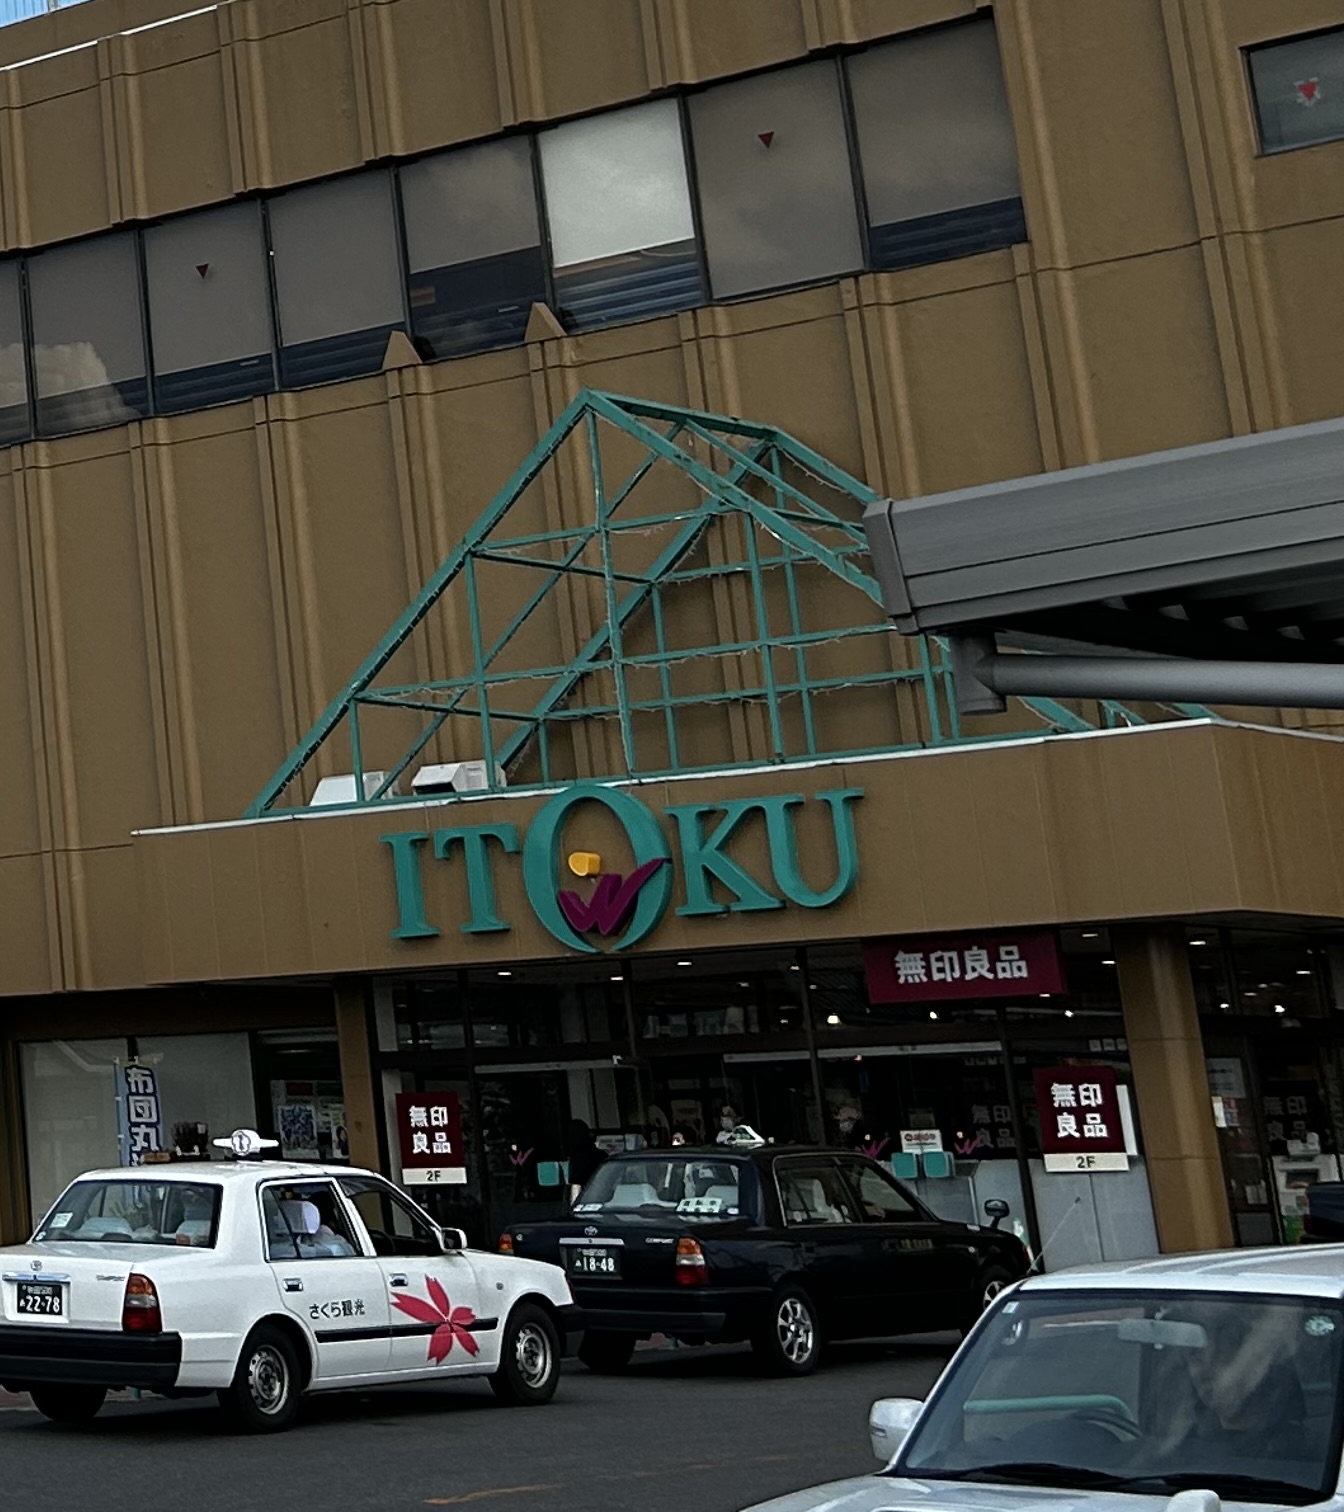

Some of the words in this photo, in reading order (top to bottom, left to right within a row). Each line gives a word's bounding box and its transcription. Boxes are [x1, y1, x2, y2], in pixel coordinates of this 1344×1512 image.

[380, 782, 866, 954] ITOKU
[894, 945, 1029, 984] 無印良品
[1051, 1082, 1103, 1108] 無印
[408, 1104, 449, 1128] 無印
[1056, 1111, 1109, 1139] 良品
[412, 1130, 452, 1154] 良品
[1075, 1155, 1096, 1169] 2F
[425, 1170, 441, 1182] 2F
[25, 1294, 60, 1314] 22-78
[309, 1299, 365, 1319] さくら観光
